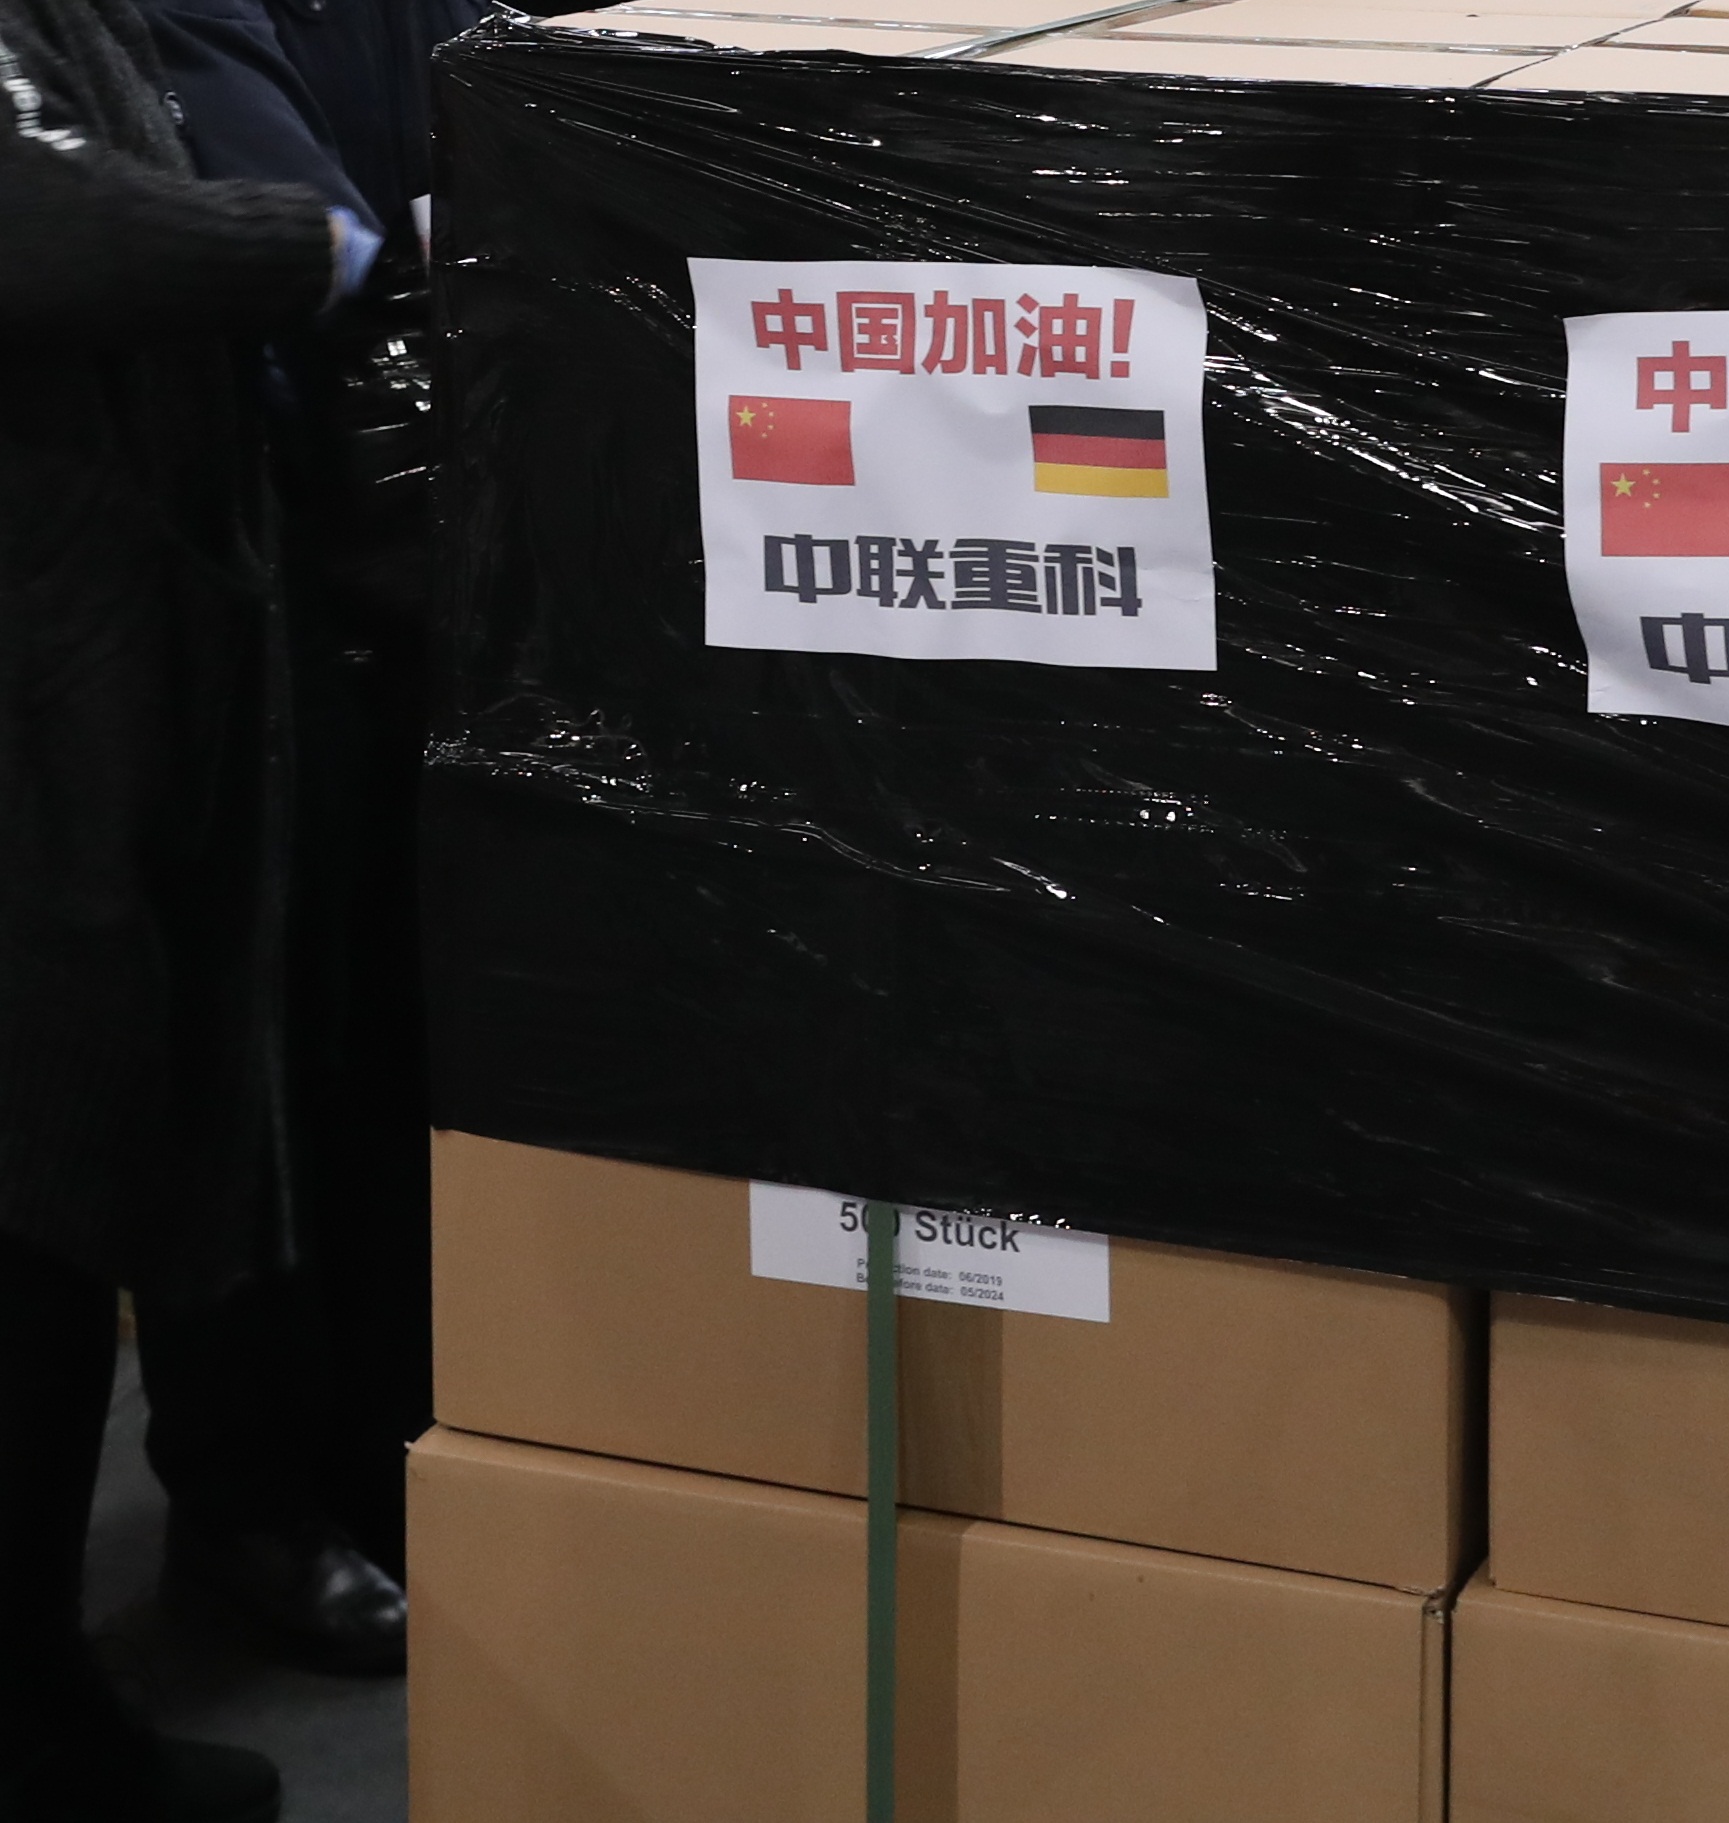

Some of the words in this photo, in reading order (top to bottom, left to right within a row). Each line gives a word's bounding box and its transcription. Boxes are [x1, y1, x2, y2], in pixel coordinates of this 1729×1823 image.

[750, 288, 1136, 380] 中国加油!
[763, 533, 1143, 617] 中联重科
[915, 1209, 1021, 1253] Stück
